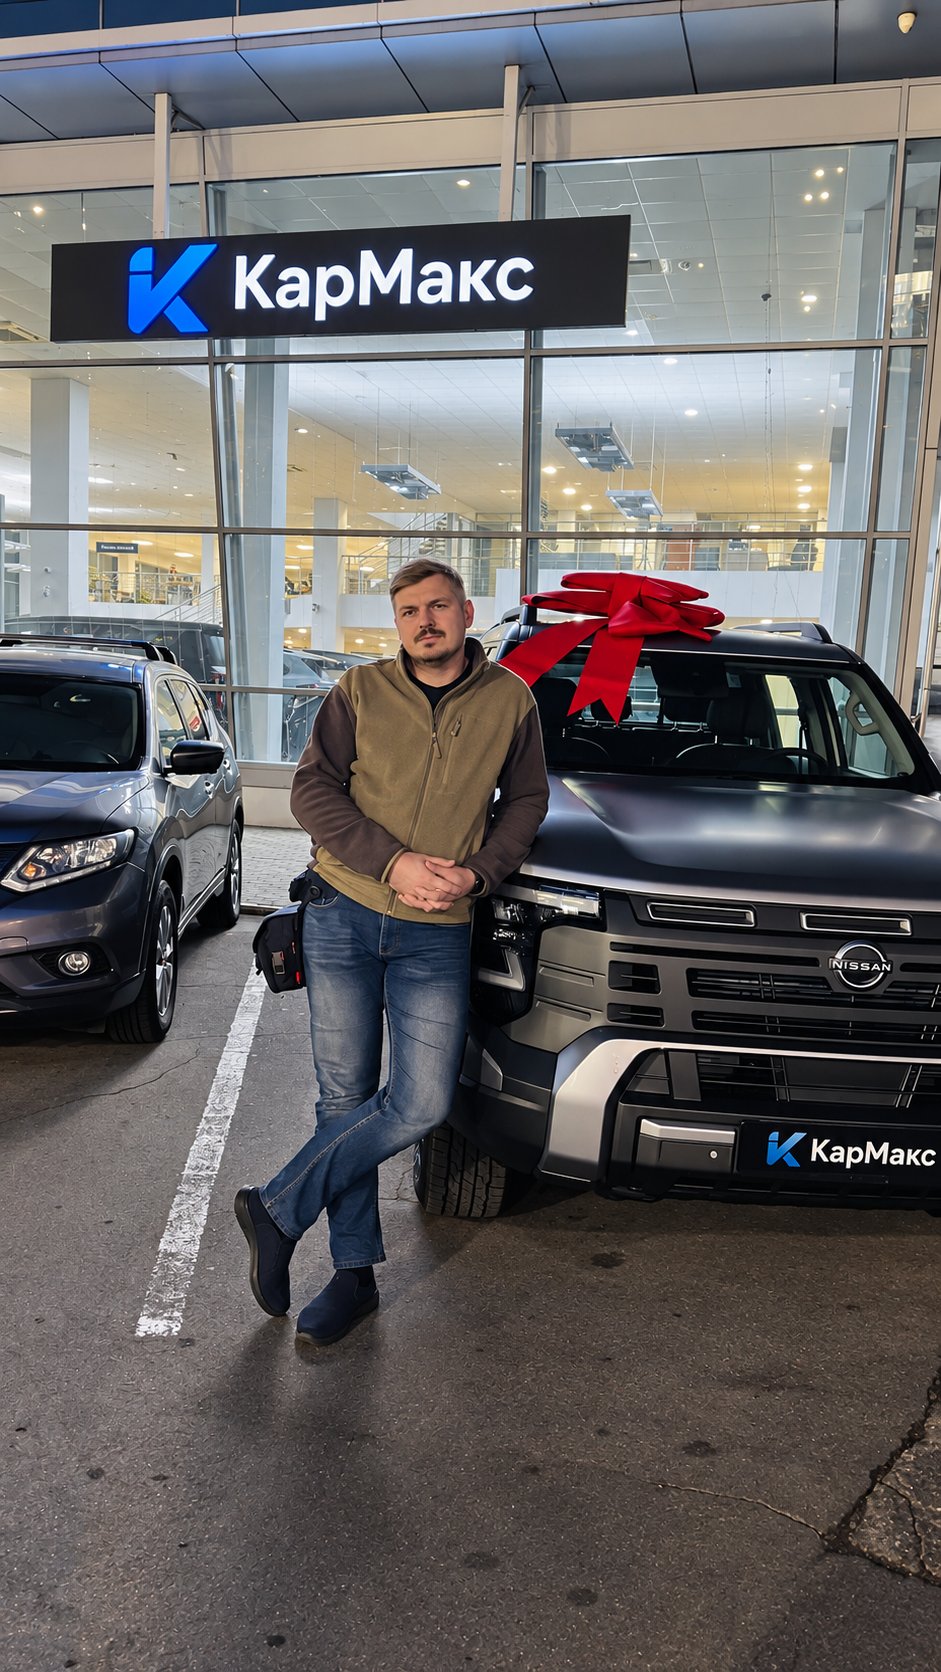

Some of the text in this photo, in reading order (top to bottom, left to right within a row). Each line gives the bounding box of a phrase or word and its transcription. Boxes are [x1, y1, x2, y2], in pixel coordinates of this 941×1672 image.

[234, 248, 535, 322] КарМакс
[832, 960, 891, 972] NISSAN
[810, 1138, 937, 1169] КарМакс
